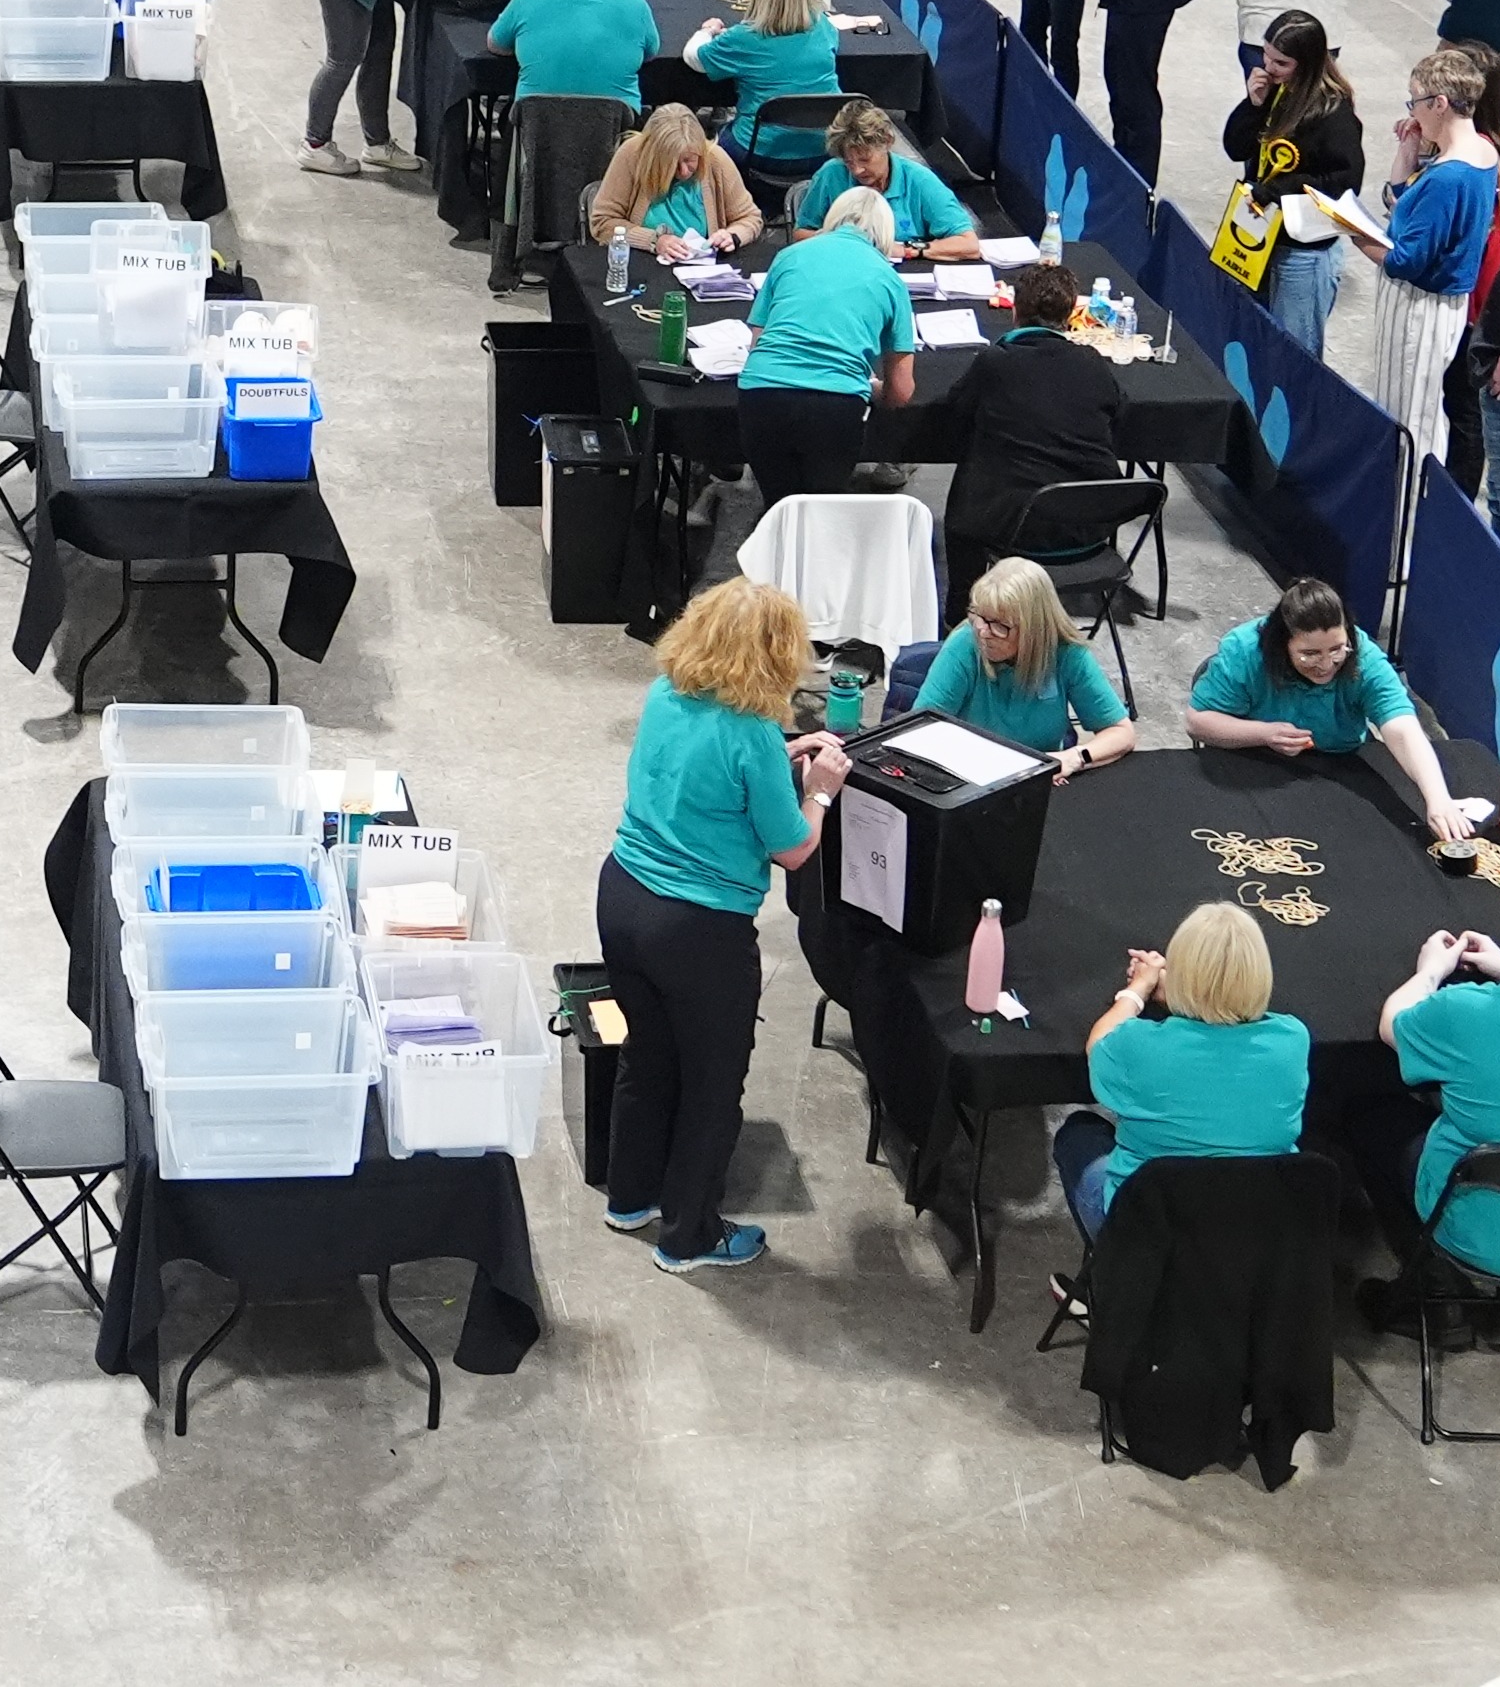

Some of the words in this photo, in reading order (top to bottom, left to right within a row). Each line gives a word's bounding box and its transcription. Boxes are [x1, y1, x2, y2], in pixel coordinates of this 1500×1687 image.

[142, 8, 164, 18] MIX
[168, 9, 193, 19] TUB
[122, 255, 149, 268] MIX
[155, 257, 187, 272] TUB
[1232, 247, 1248, 263] JIM
[1221, 255, 1251, 280] FAIRLIE
[229, 337, 256, 349] MIX
[262, 337, 293, 350] TUB
[239, 388, 308, 397] DOUBTFULS
[368, 833, 403, 849] MIX
[411, 834, 452, 851] TUB
[870, 851, 887, 870] 93
[405, 1052, 444, 1070] MIX
[451, 1047, 496, 1069] TUB
